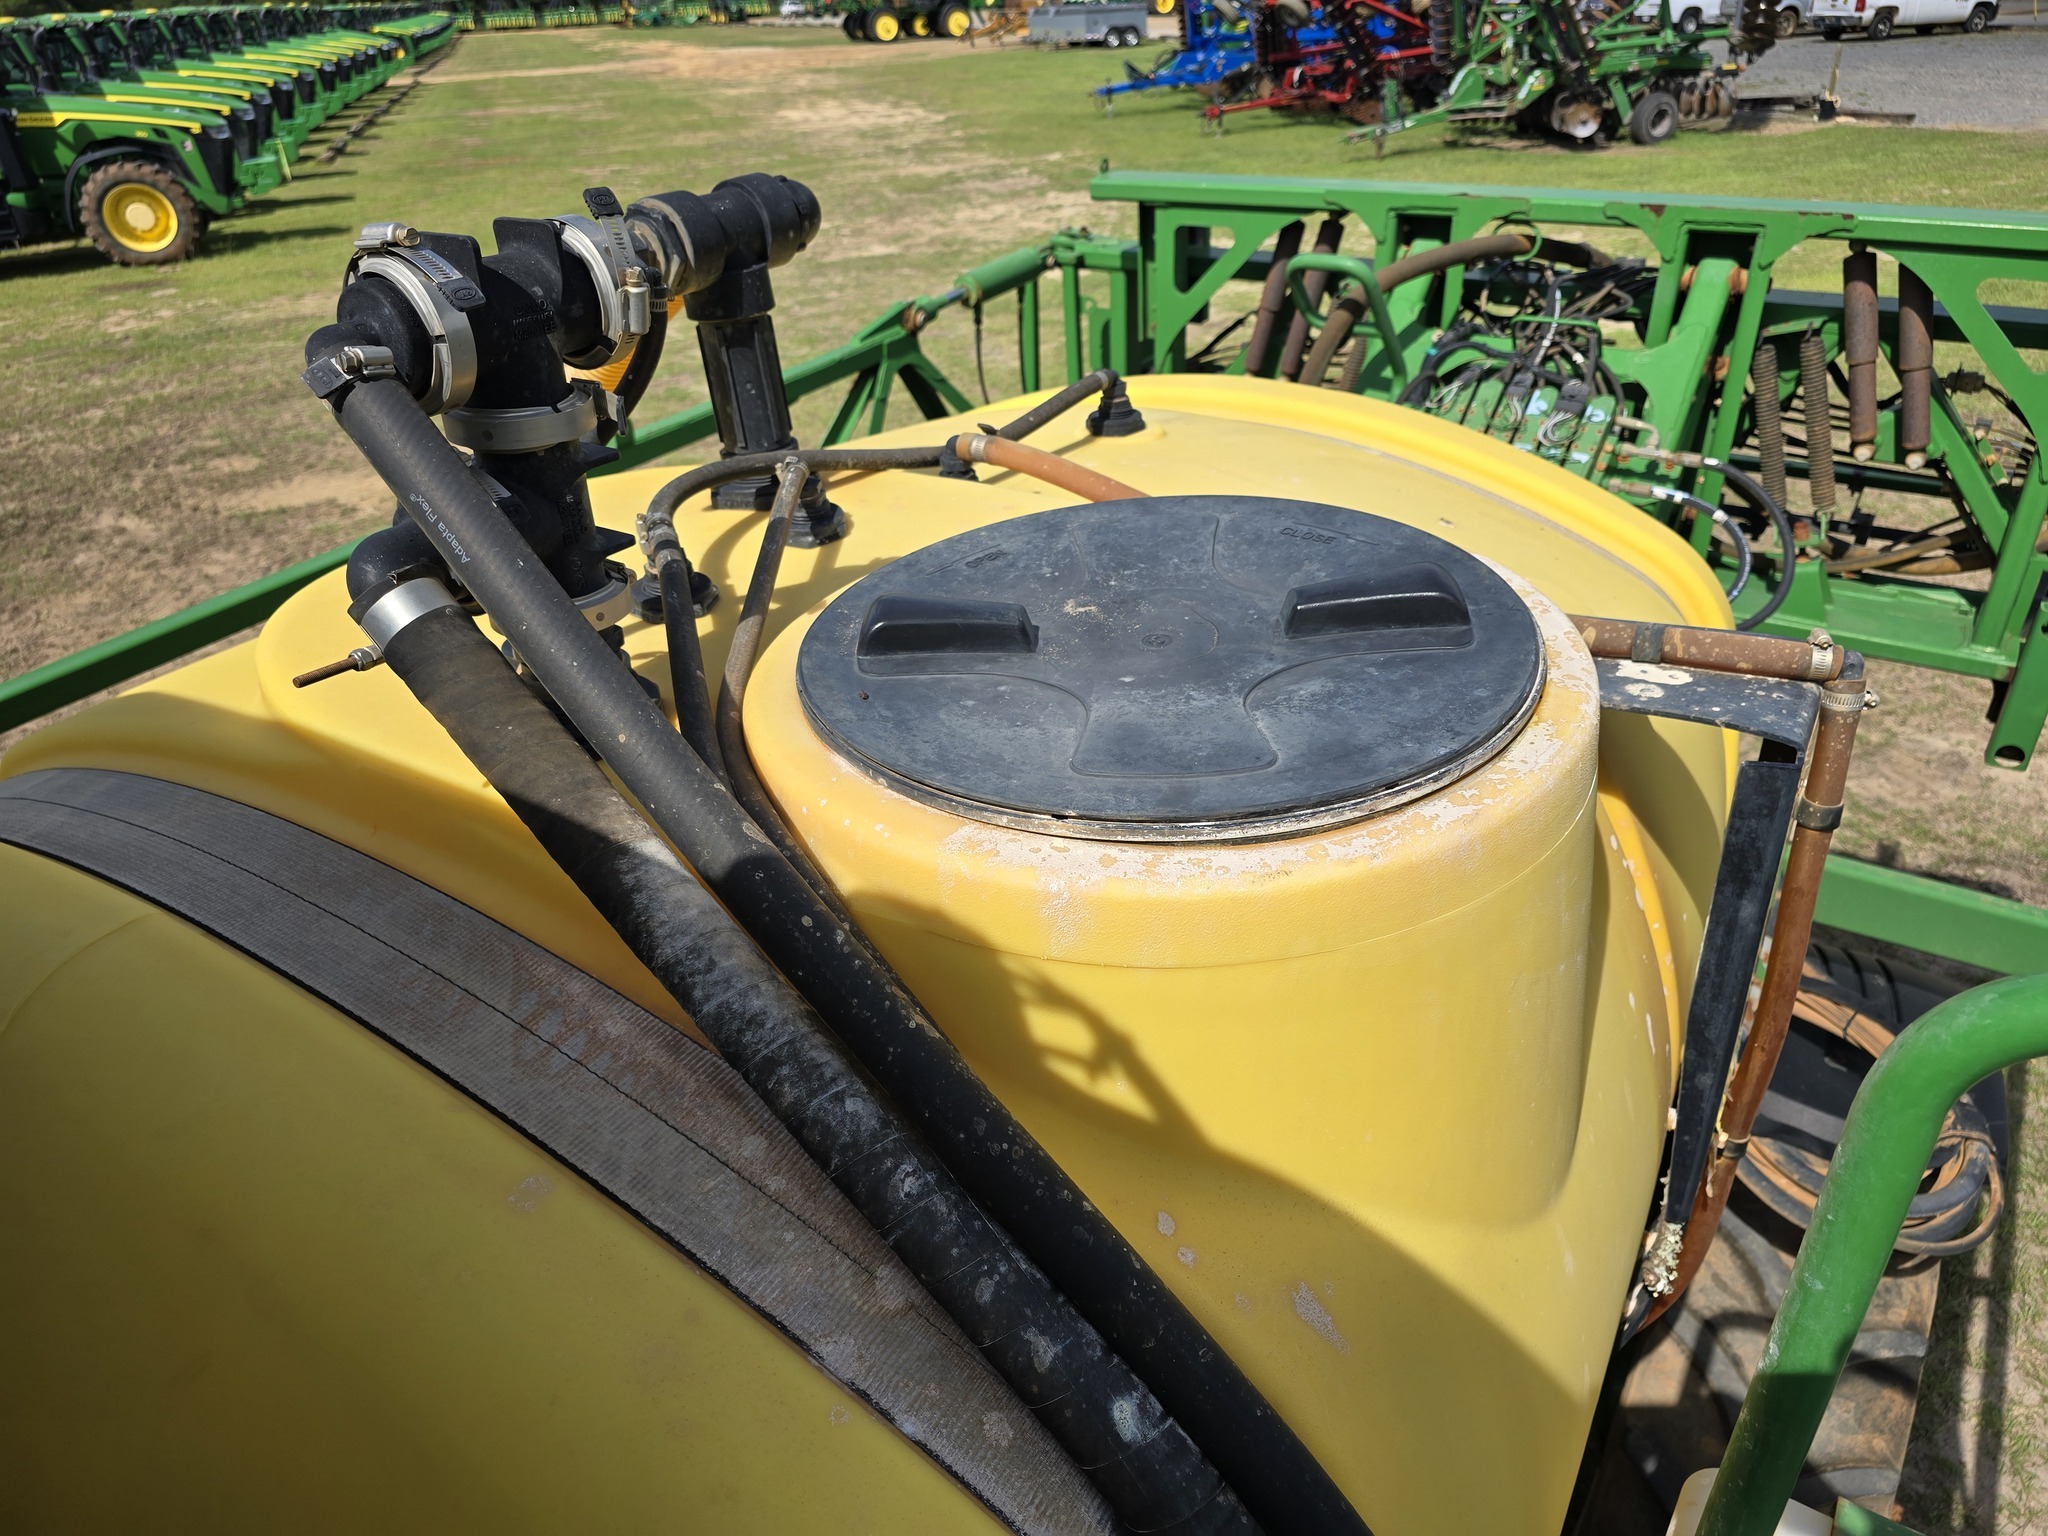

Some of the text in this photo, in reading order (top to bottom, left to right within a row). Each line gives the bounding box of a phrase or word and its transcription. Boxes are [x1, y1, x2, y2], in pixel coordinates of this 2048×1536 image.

[438, 521, 471, 563] Adapta
[1279, 527, 1338, 545] CLOSE
[965, 550, 1008, 569] OPEN
